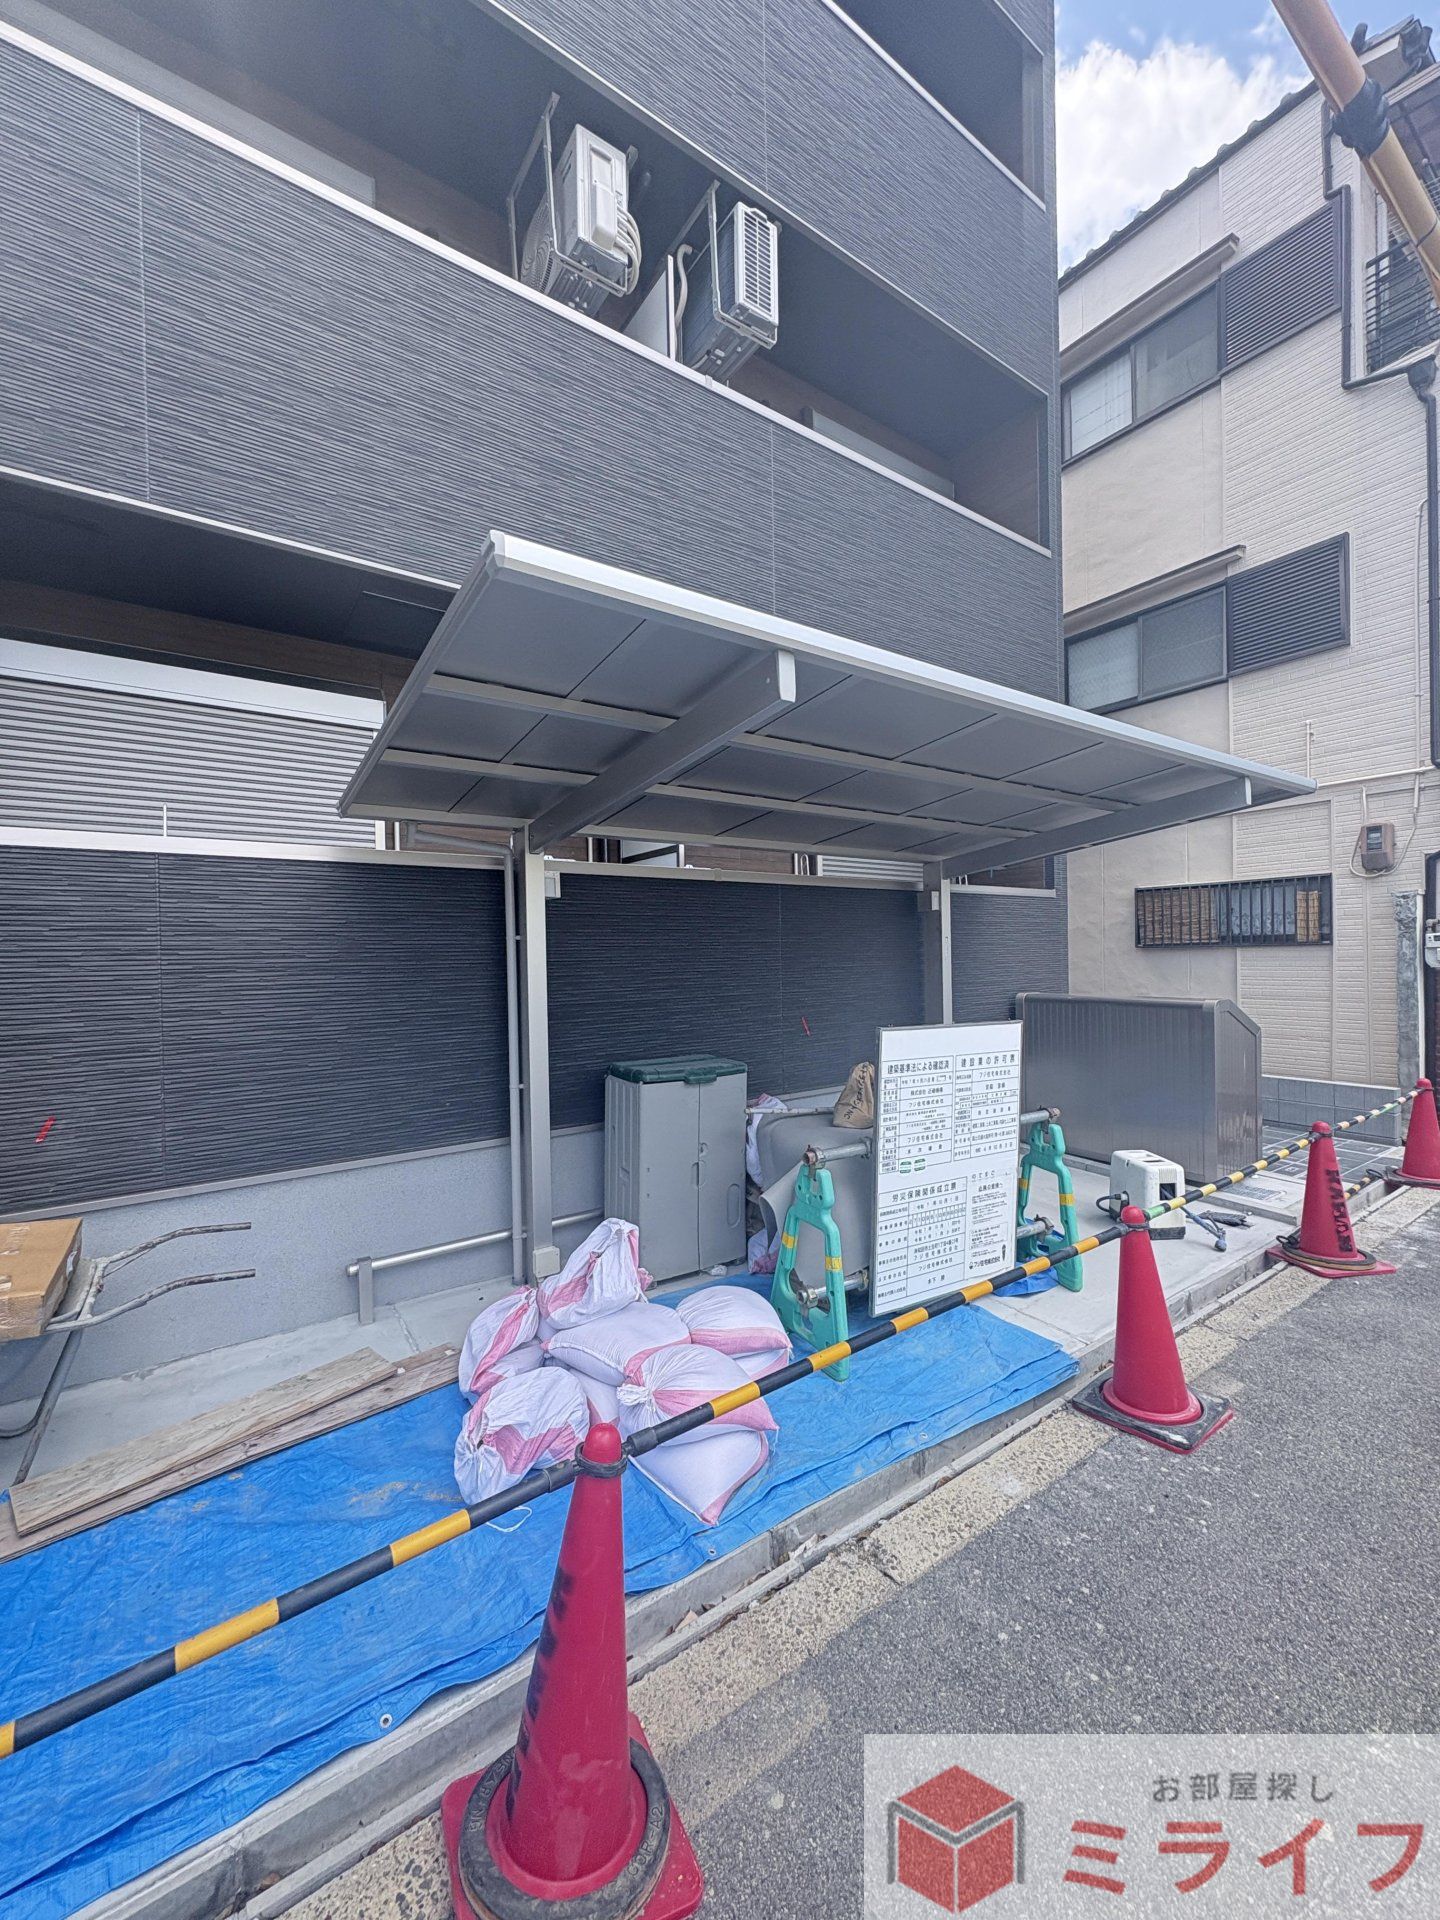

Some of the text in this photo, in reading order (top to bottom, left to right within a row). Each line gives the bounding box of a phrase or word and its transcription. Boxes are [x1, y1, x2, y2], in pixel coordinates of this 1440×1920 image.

[888, 1060, 949, 1074] 建築基準法による確認済
[892, 1182, 957, 1203] 労災保険関係成立票
